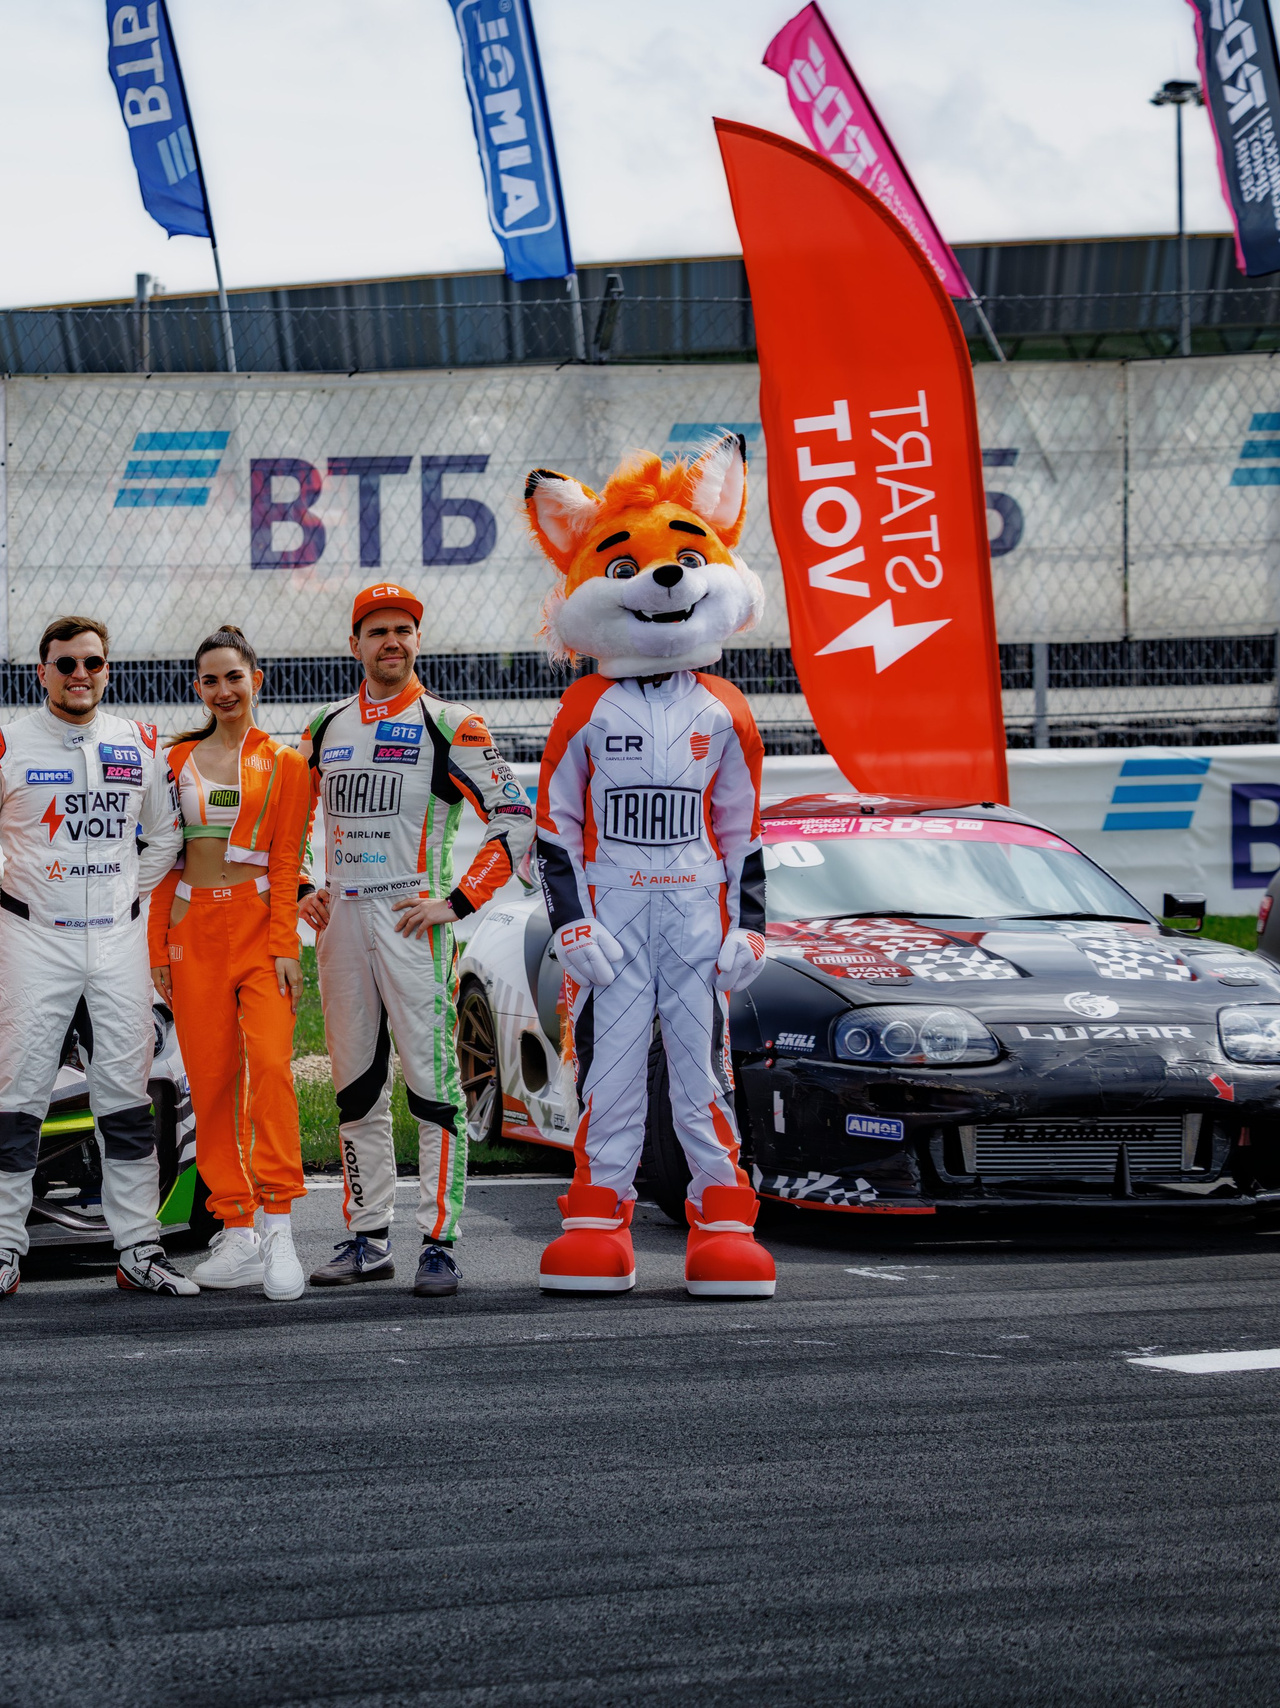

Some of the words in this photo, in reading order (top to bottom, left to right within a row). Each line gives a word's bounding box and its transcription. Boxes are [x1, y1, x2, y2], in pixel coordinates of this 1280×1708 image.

[250, 453, 497, 570] ВТБ
[372, 586, 399, 597] CR
[365, 705, 389, 719] CR
[391, 726, 417, 739] ВТБ
[73, 736, 84, 744] CR
[606, 735, 643, 752] CR
[114, 750, 138, 762] ВТБ
[377, 748, 404, 757] RDS
[29, 772, 70, 781] AIMOL
[106, 766, 131, 777] RDS
[131, 768, 142, 776] GP
[210, 791, 239, 806] TRIALL
[328, 773, 397, 814] TRIALLI
[65, 791, 130, 815] START
[610, 792, 696, 840] TRIALLI
[764, 818, 851, 827] РОССИЙСКАЯ
[66, 817, 126, 841] VOLT
[858, 817, 954, 834] RDS
[346, 831, 391, 839] AIRLINE
[345, 852, 387, 864] OutSale
[70, 863, 121, 876] AIRLINE
[477, 851, 500, 883] AIRLINE
[650, 873, 696, 883] AIRLINE
[213, 889, 232, 898] CR
[363, 885, 389, 894] ANTON
[391, 880, 421, 890] KOZLOV
[561, 925, 592, 947] CR
[566, 973, 575, 1028] RVILLE
[1017, 1024, 1196, 1041] LUZAR
[775, 1032, 816, 1048] SKILL
[849, 1119, 901, 1136] AIMOL
[343, 1140, 364, 1207] KOZLOV
